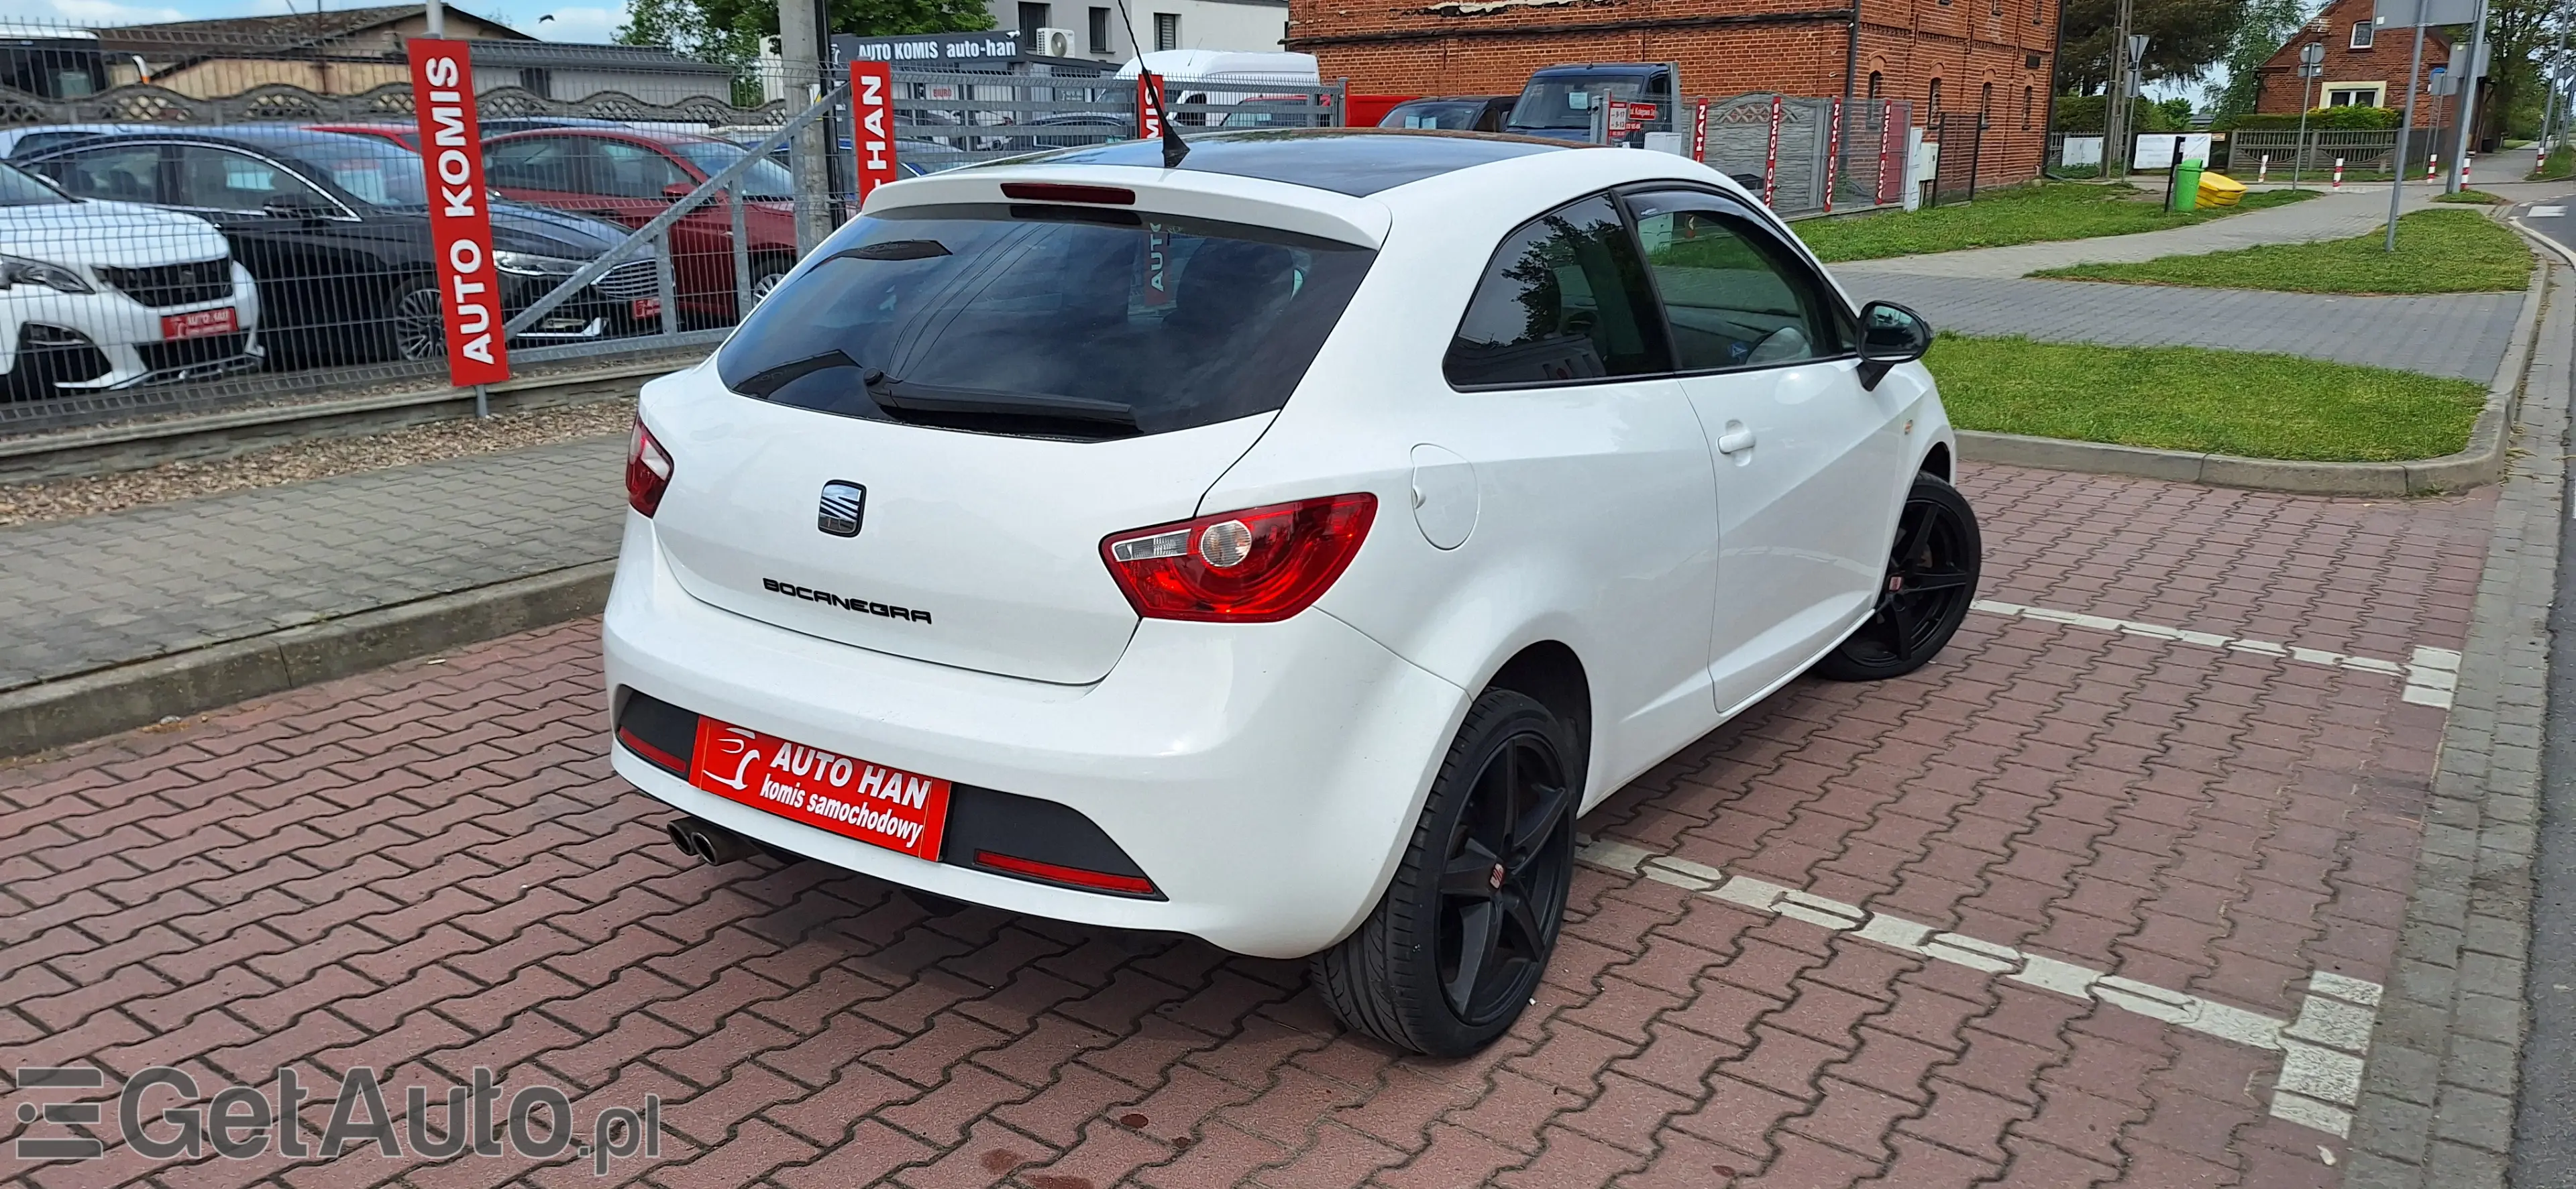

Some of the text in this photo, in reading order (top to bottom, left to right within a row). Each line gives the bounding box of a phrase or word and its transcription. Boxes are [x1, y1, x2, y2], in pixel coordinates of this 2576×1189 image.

[859, 39, 1016, 61] AUTO KOMIS auto-han
[933, 88, 952, 98] BIURO
[861, 75, 888, 170] HAN
[1696, 105, 1706, 152] HAN
[1769, 103, 1779, 160] KOMIS
[1882, 105, 1890, 154] KOMIS
[1826, 156, 1835, 206] AUTO
[1831, 103, 1840, 143] HAN
[425, 56, 495, 365] AUTO KOMIS
[762, 577, 932, 625] BOCANEGRA
[769, 742, 931, 810] AUTO HAN
[759, 773, 924, 848] komis samochodowy
